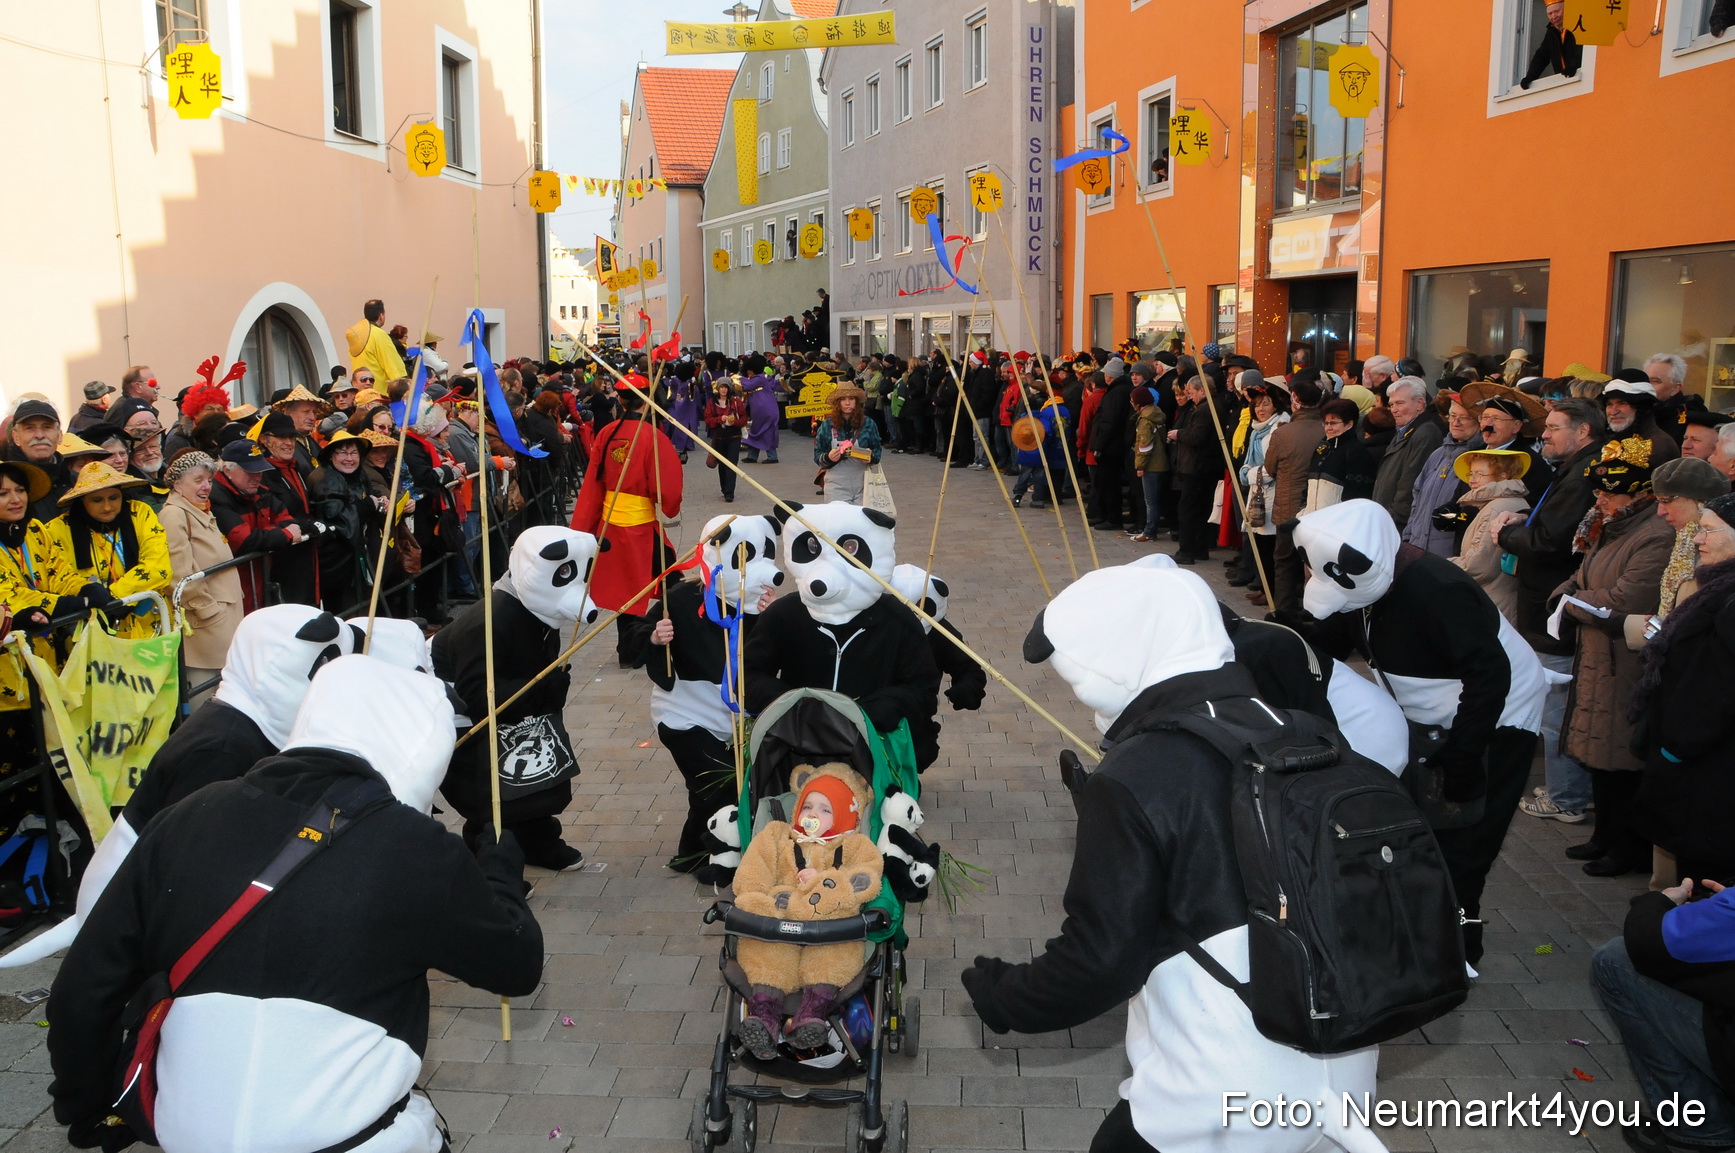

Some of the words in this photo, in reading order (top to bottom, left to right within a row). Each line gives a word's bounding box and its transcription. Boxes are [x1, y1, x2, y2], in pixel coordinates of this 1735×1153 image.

[1030, 27, 1042, 122] UHREN
[1028, 137, 1042, 270] SCHMUCK
[867, 268, 902, 300] OPTIK
